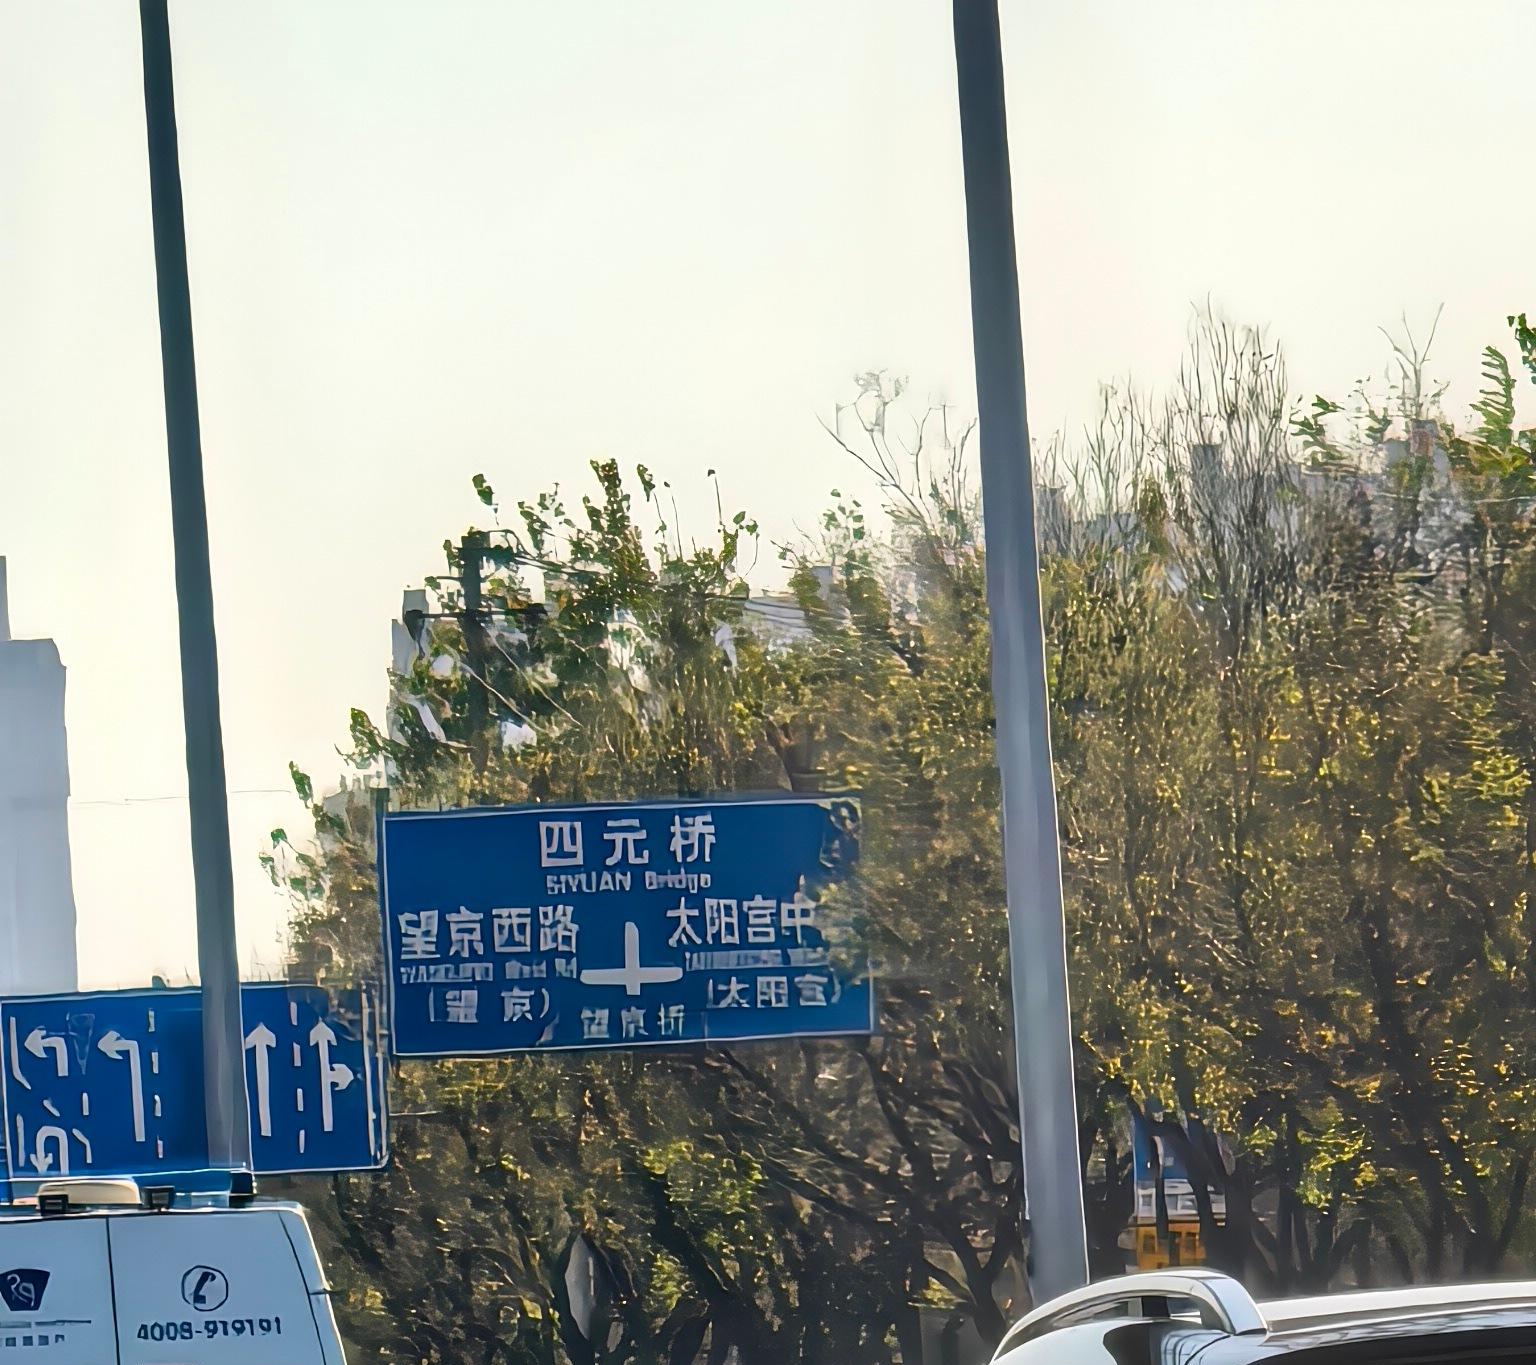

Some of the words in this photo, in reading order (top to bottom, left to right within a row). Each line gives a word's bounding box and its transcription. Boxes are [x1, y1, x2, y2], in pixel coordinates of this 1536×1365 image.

[539, 811, 716, 867] 四元桥
[546, 871, 631, 895] SIYUAN
[398, 905, 580, 960] 望京西路
[137, 1317, 281, 1341] 4008-919191
